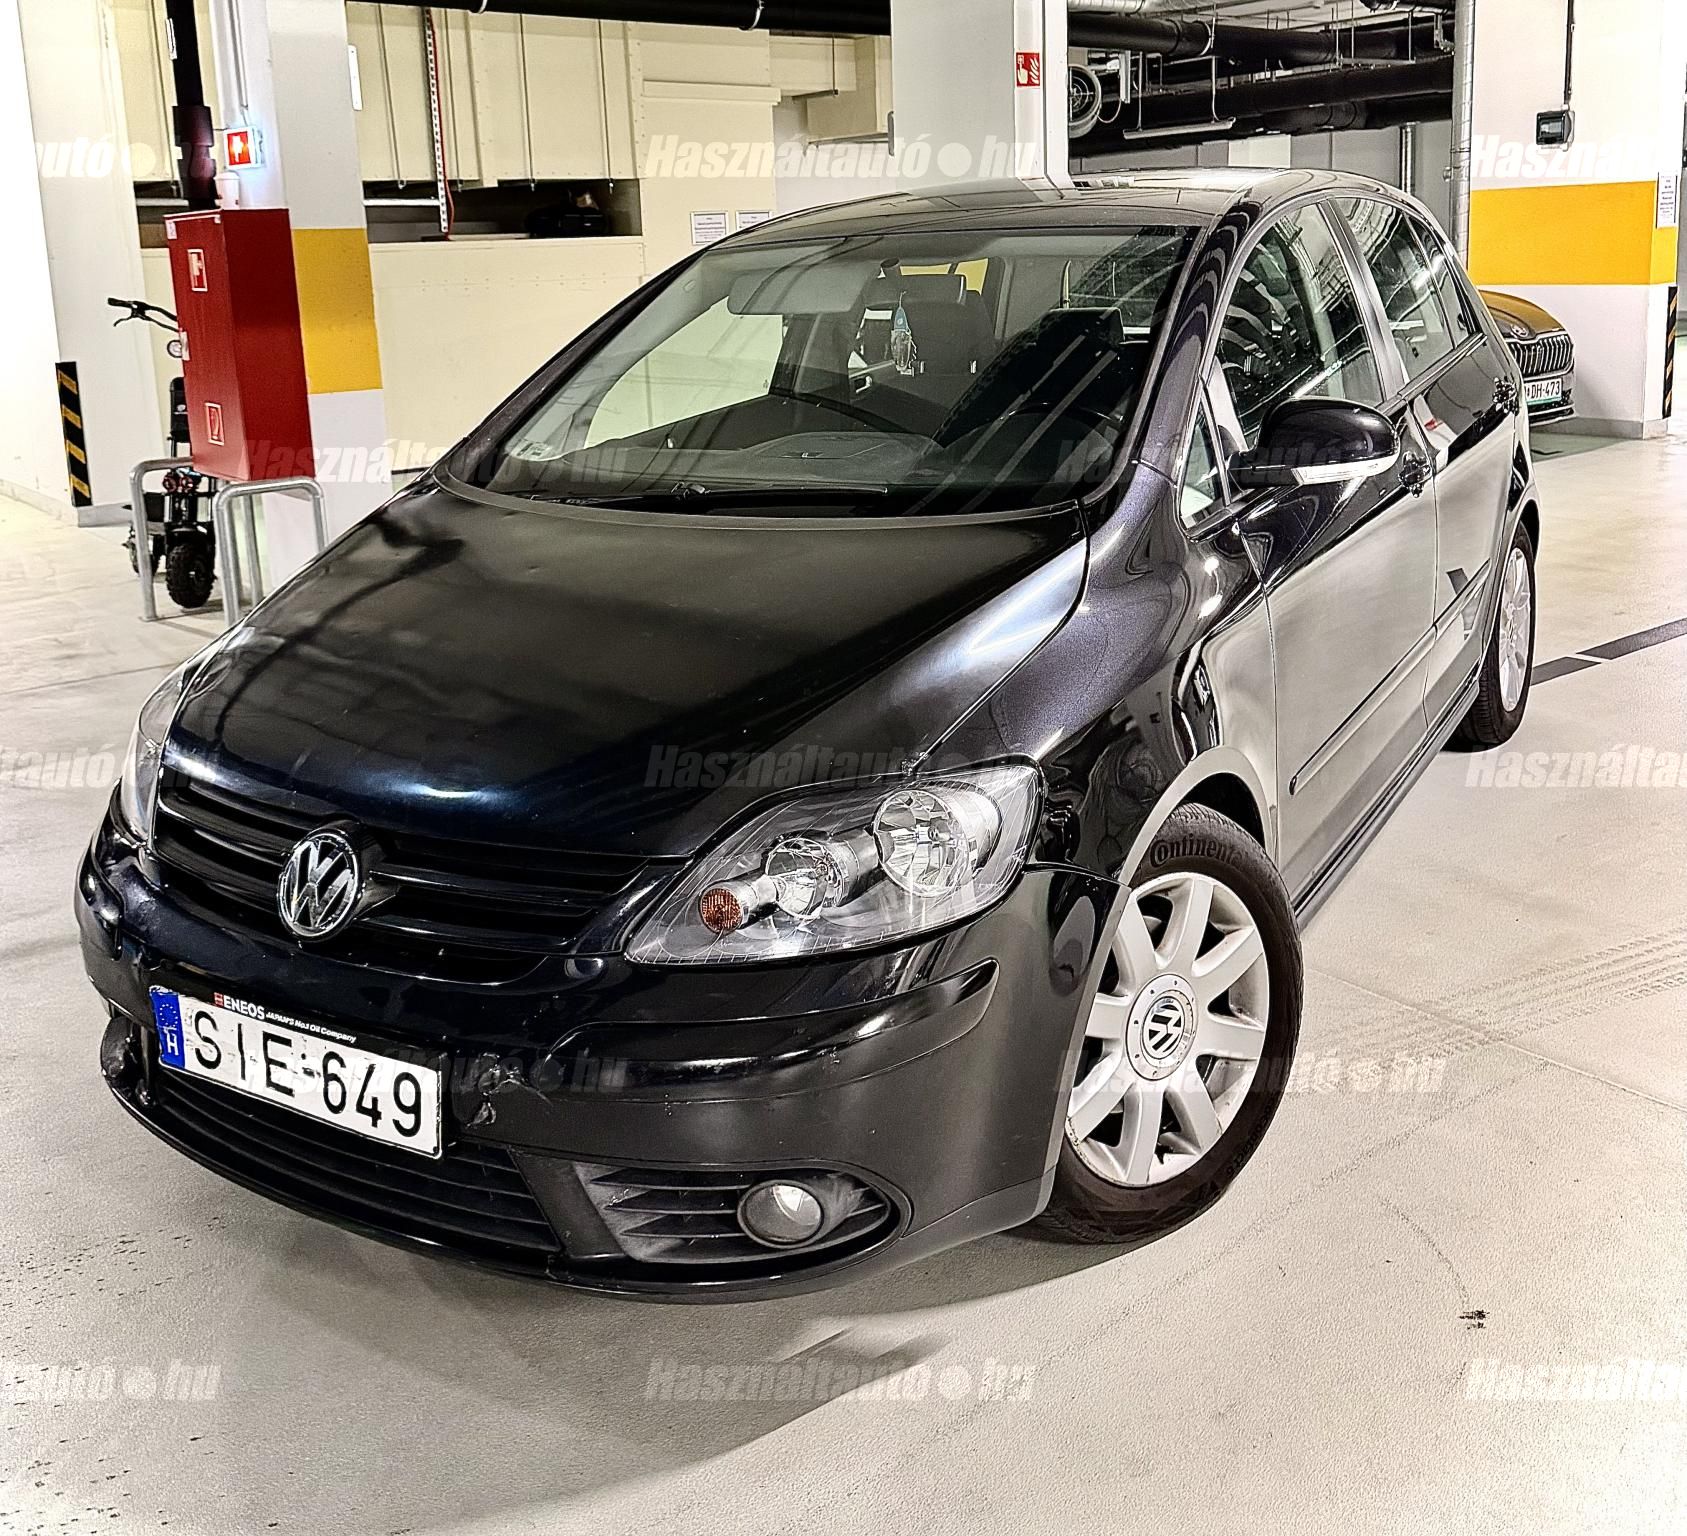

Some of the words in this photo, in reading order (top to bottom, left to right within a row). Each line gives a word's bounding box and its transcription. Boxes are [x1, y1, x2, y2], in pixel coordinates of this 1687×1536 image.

[223, 995, 265, 1019] ENEOS
[320, 1027, 357, 1044] Company
[164, 1028, 179, 1056] H
